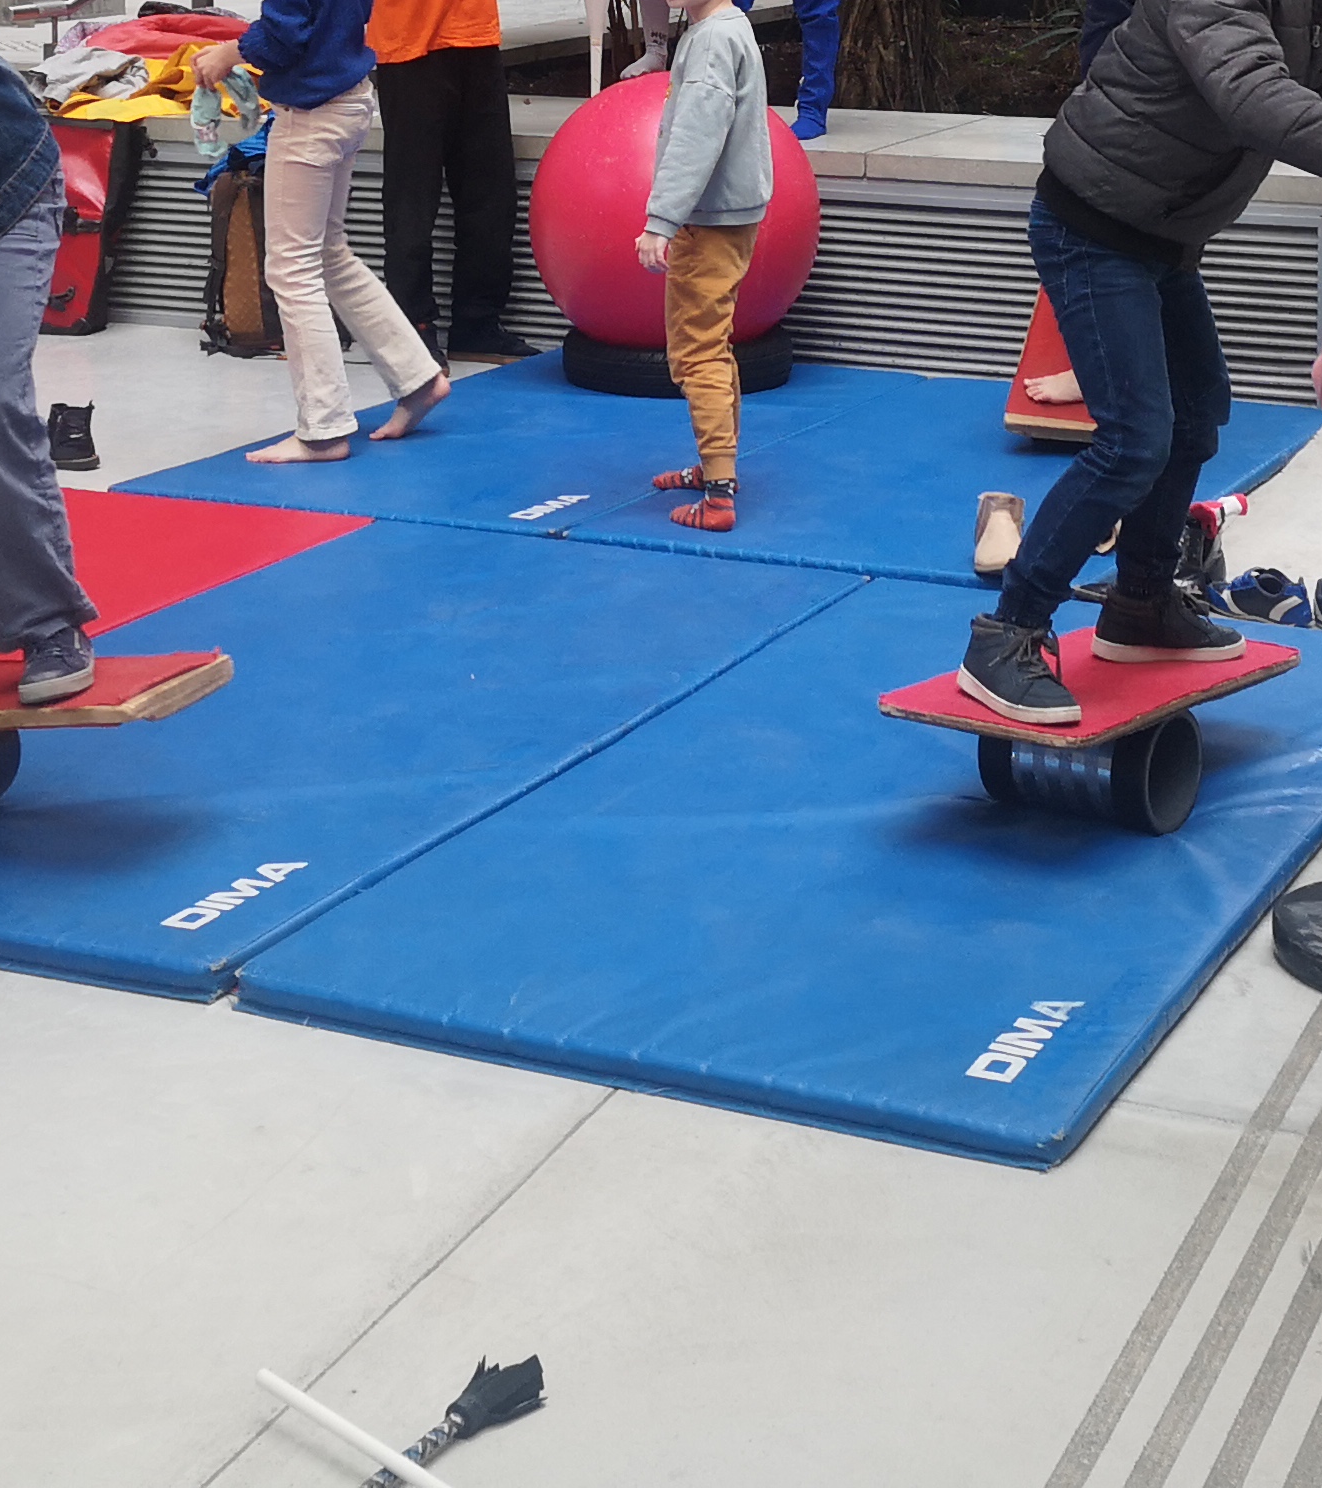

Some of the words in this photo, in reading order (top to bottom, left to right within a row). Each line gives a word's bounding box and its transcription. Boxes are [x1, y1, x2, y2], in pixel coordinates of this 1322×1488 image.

[508, 494, 591, 521] DIMA
[160, 861, 309, 930] DIMA
[965, 1001, 1086, 1083] DIMA
